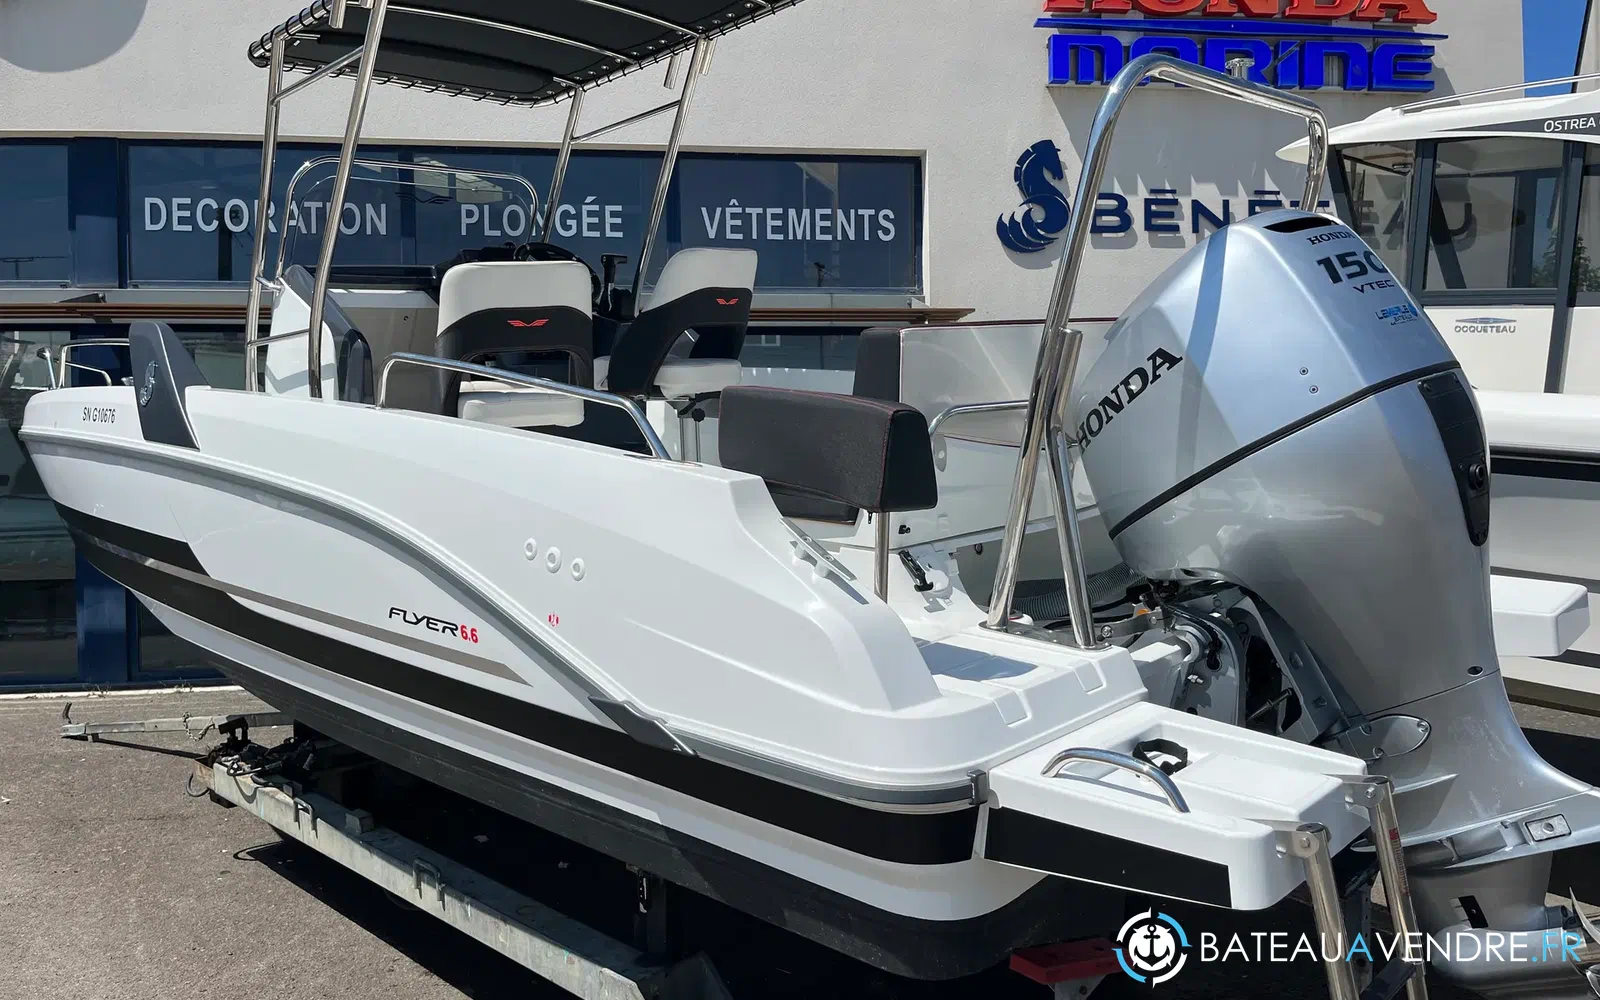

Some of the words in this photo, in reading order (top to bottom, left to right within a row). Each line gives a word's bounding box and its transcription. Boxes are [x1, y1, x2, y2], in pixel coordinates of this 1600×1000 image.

[1048, 33, 1435, 91] MARINE
[1544, 116, 1597, 132] OSTREA
[460, 195, 624, 238] PLONGÉE
[701, 198, 896, 242] VÊTEMENTS
[1307, 230, 1356, 245] HONDA
[1316, 250, 1389, 285] 150
[1352, 279, 1396, 294] VTEC
[1454, 325, 1517, 334] OCQUETEAU
[1075, 347, 1184, 456] HONDA
[82, 406, 92, 422] SN
[92, 407, 116, 424] G10676
